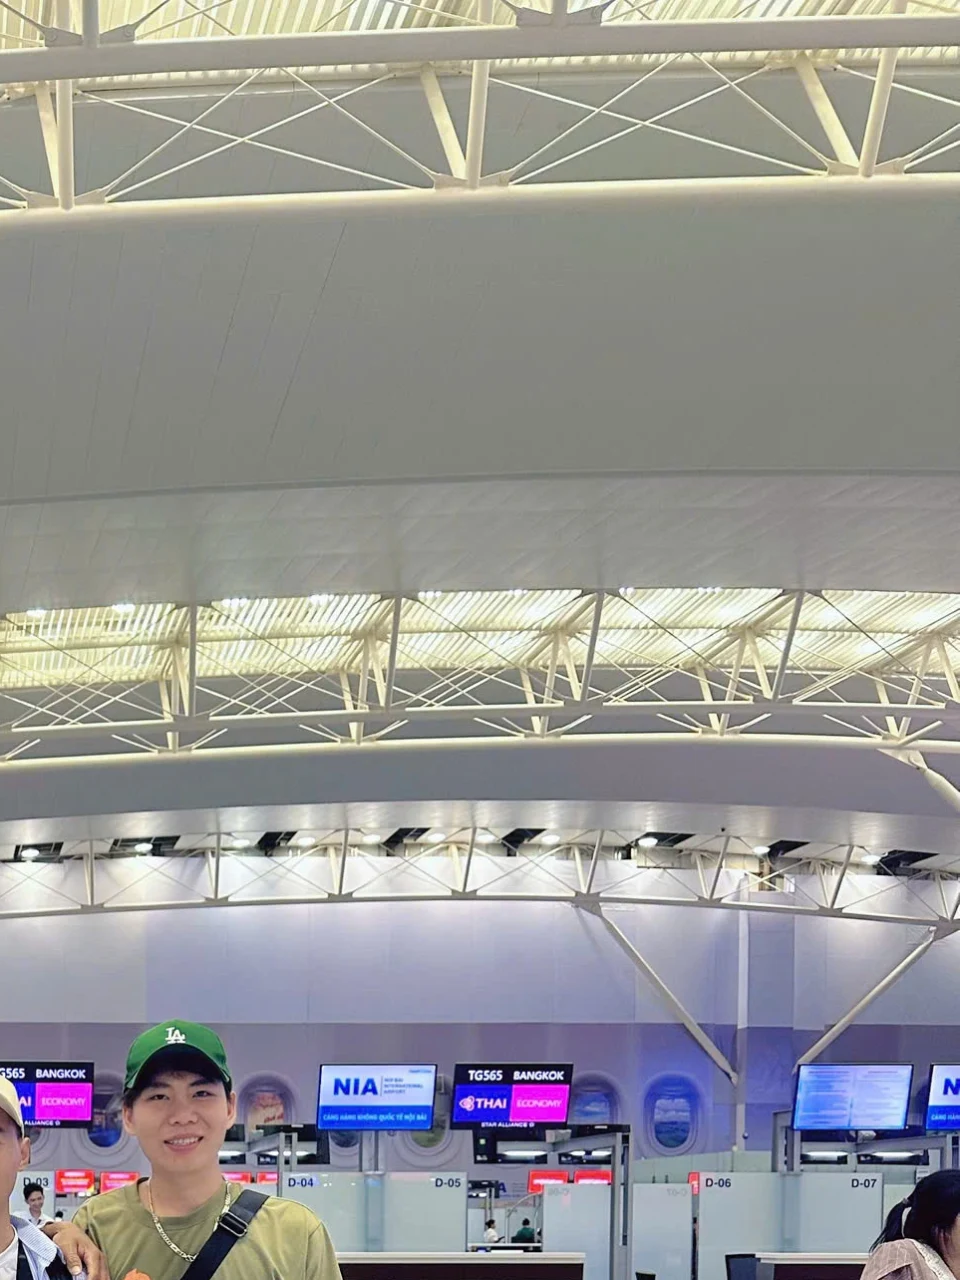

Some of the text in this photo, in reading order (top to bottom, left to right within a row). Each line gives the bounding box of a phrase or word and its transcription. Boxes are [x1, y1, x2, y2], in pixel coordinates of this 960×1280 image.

[165, 1027, 186, 1044] LA
[36, 1069, 86, 1079] BANGKOK
[468, 1070, 564, 1081] TG565 BANGKOK
[333, 1078, 378, 1095] NIA
[19, 1096, 32, 1107] AI
[41, 1097, 86, 1106] ECONOMY
[476, 1098, 507, 1109] THAI
[516, 1099, 562, 1108] ECONOMY
[23, 1177, 49, 1187] D03
[288, 1178, 314, 1187] D-04
[435, 1178, 461, 1187] D-05
[705, 1178, 731, 1188] D-06
[851, 1178, 877, 1188] D-07
